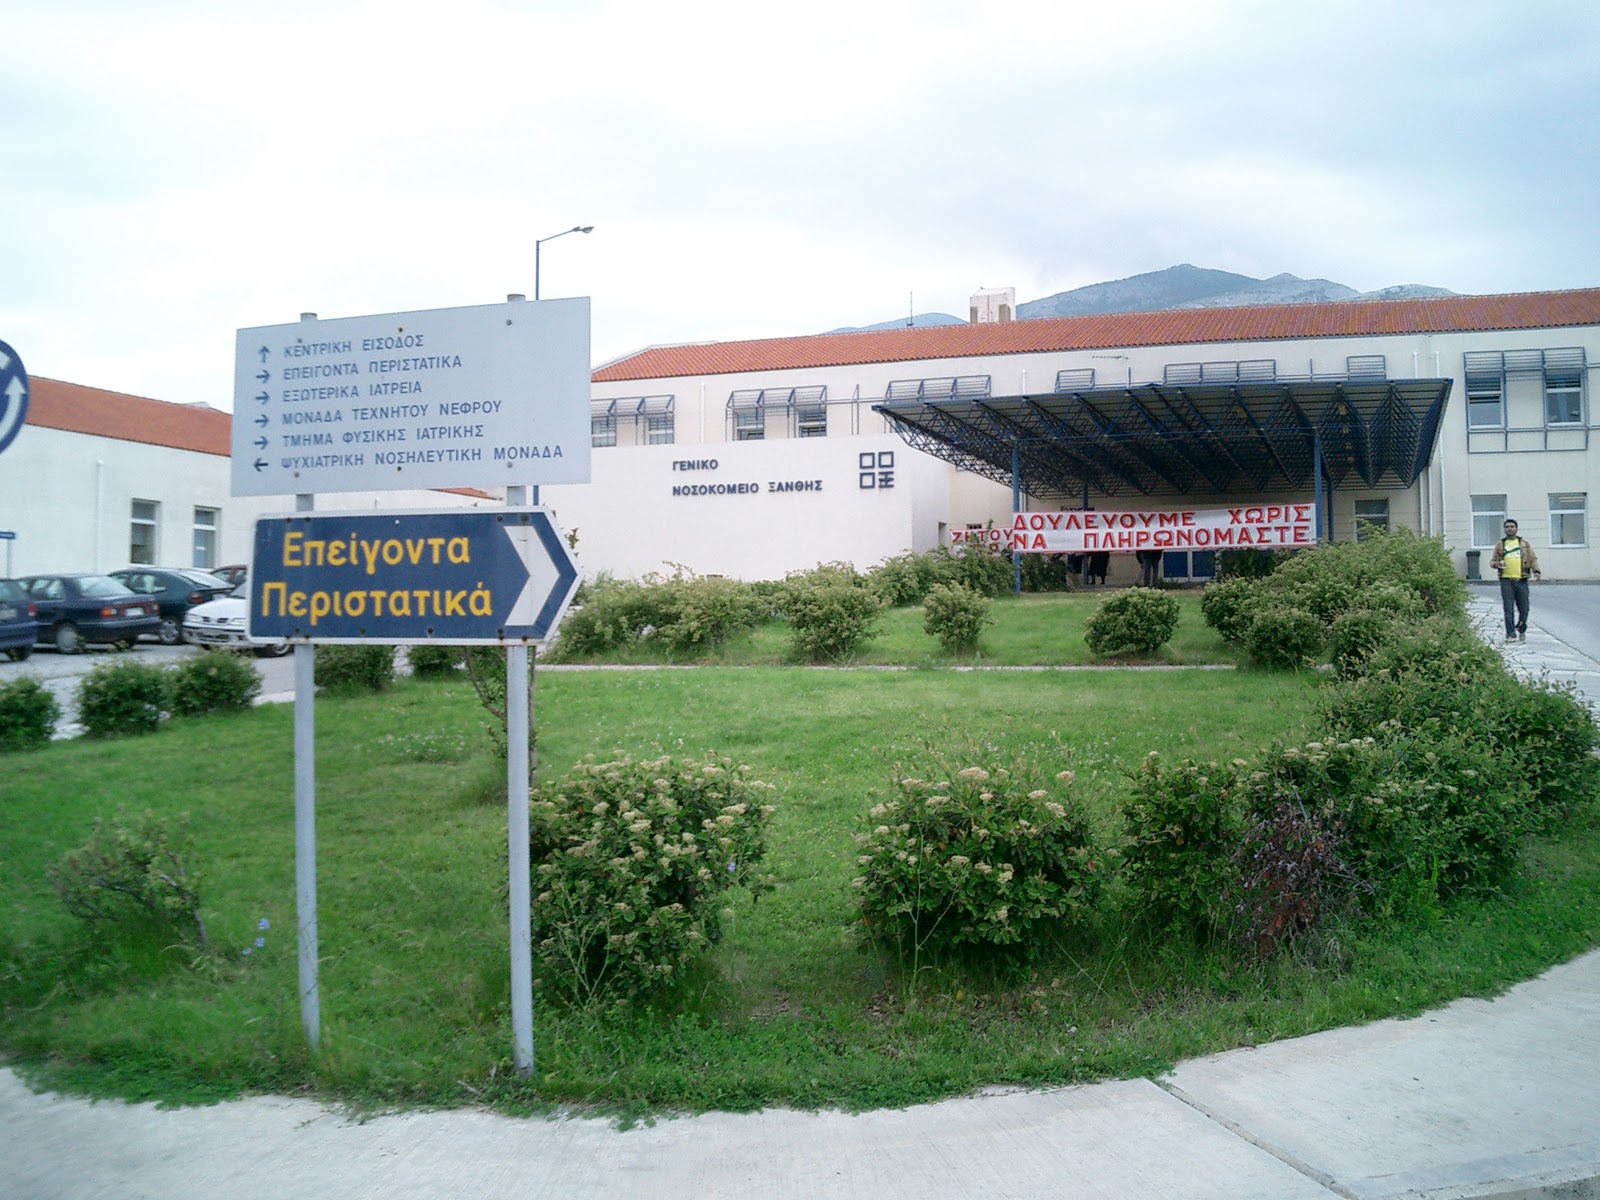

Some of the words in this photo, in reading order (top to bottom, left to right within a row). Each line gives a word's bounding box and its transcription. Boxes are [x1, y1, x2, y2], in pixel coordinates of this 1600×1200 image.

[284, 341, 352, 357] ΚΕΝΤΡΙΚΗ
[362, 335, 424, 351] ΕΙΣΟΔΟΣ
[283, 363, 359, 380] ΕΠΕΙΓΟΝΤΑ
[369, 355, 462, 373] ΠΕΡΙΣΤΑΤΙΚΑ
[282, 386, 360, 402] ΕΞΩΤΕΡΙΚΑ
[369, 381, 423, 396] ΙΑΤΡΕΙΑ
[282, 410, 343, 425] ΜΟΝΑΔΑ
[352, 404, 429, 421] ΤΕΧΝΗΤΟΥ
[440, 400, 502, 416] ΝΕΦΡΟΥ
[282, 433, 334, 447] ΤΜΗΜΑ
[342, 429, 406, 444] ΦΥΣΙΚΗΣ
[417, 425, 484, 440] ΙΑΤΡΙΚΗΣ
[281, 454, 364, 469] ΨΥΧΙΑΤΡΙΚΗ
[375, 448, 482, 465] ΝΟΣΗΛΕΥΤΙΚΗ
[493, 445, 564, 461] ΜΟΝΑΔΑ
[672, 459, 719, 471] ΓΕΝΙΚΟ
[672, 483, 759, 496] ΝΟΣΟΚΟΜΕΙΟ
[768, 480, 823, 493] ΞΑΝΘΗΣ
[1013, 512, 1196, 531] ΔΟΥΛΕΥΟΥΜΕ
[1229, 505, 1310, 525] ΧΩΡΙΣ
[1013, 532, 1047, 549] ΝΑ
[1083, 526, 1309, 549] ΠΛΗΡΩΝΟΜΑΣΤΕ
[283, 532, 470, 575] Επείγοντα
[262, 582, 493, 626] Περιστατικά
